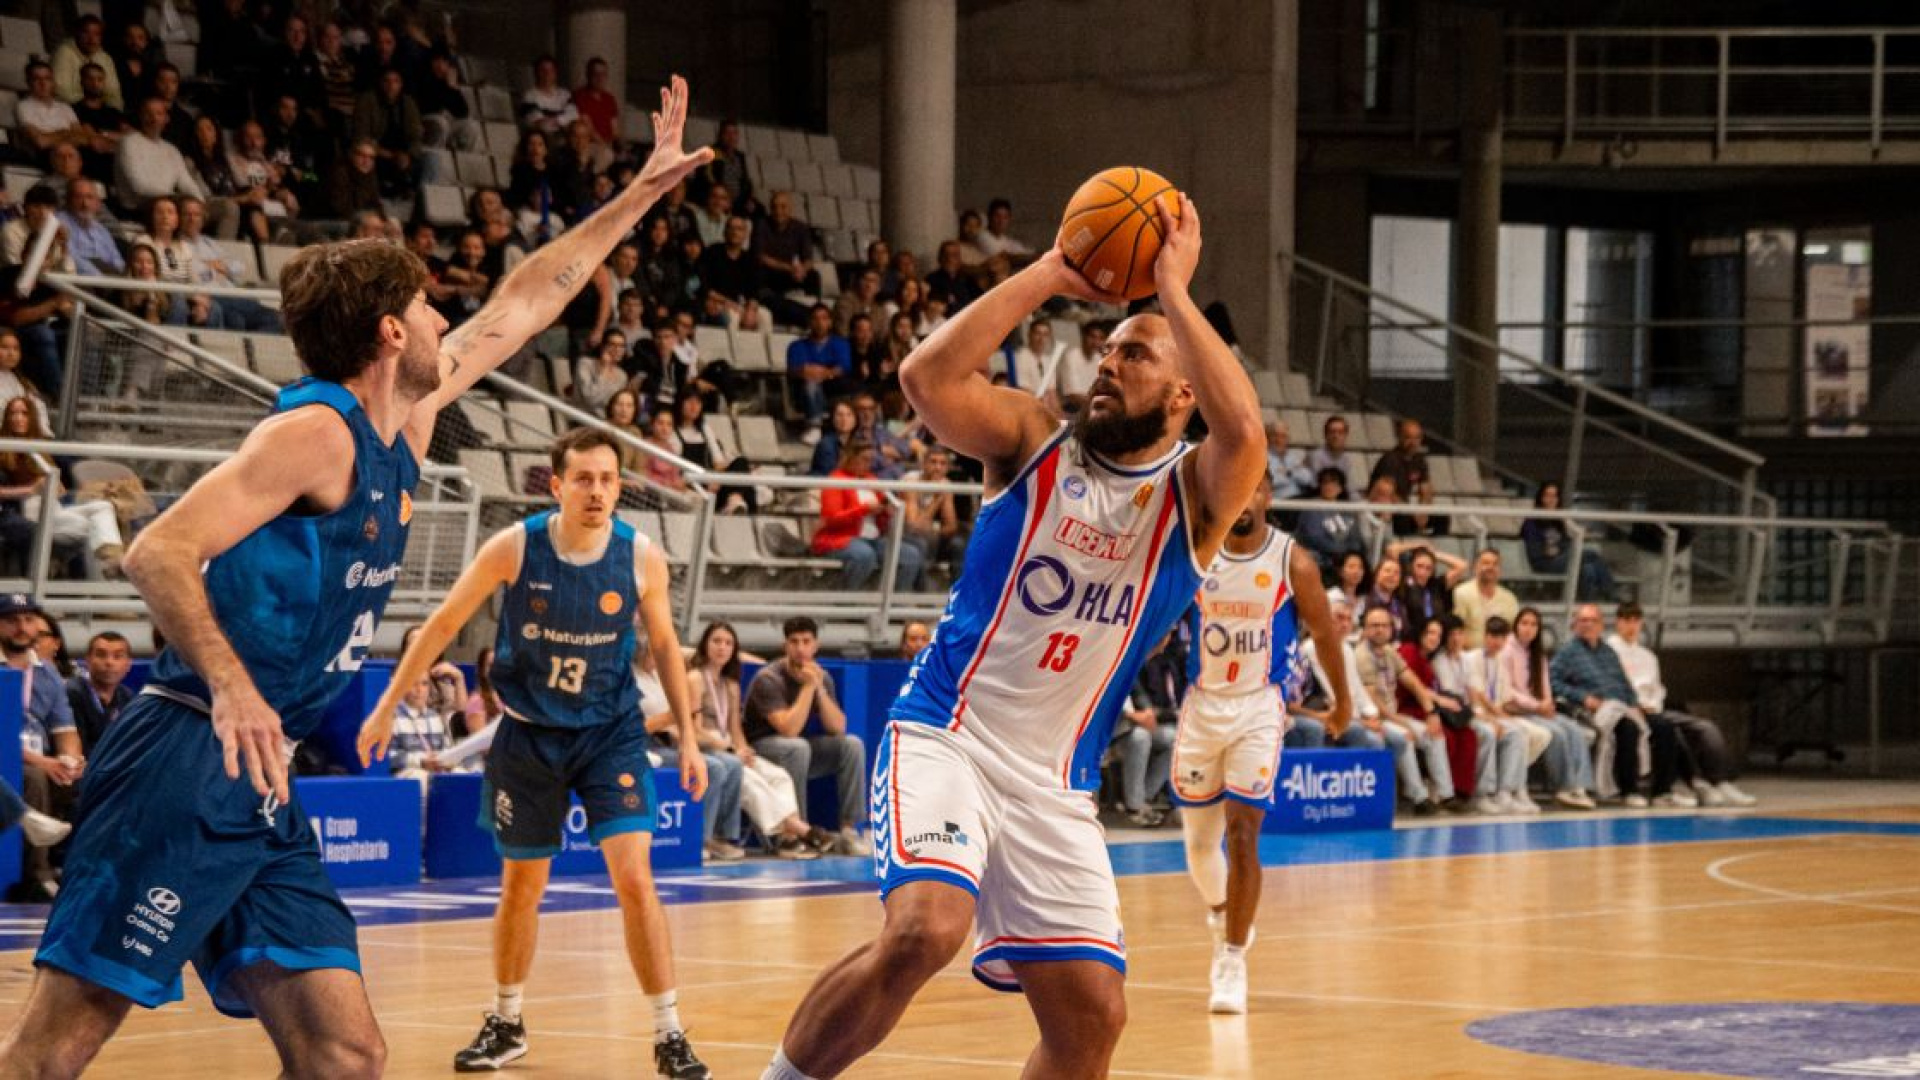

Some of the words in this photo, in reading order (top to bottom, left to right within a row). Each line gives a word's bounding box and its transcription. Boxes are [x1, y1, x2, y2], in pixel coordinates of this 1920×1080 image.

[1075, 582, 1135, 626] HLA
[1038, 631, 1080, 673] 13
[1235, 628, 1268, 655] HLA
[547, 655, 588, 695] 13
[1226, 661, 1240, 683] 0
[325, 816, 358, 839] Grupo
[905, 832, 953, 847] suma
[325, 840, 389, 864] Hospitalario
